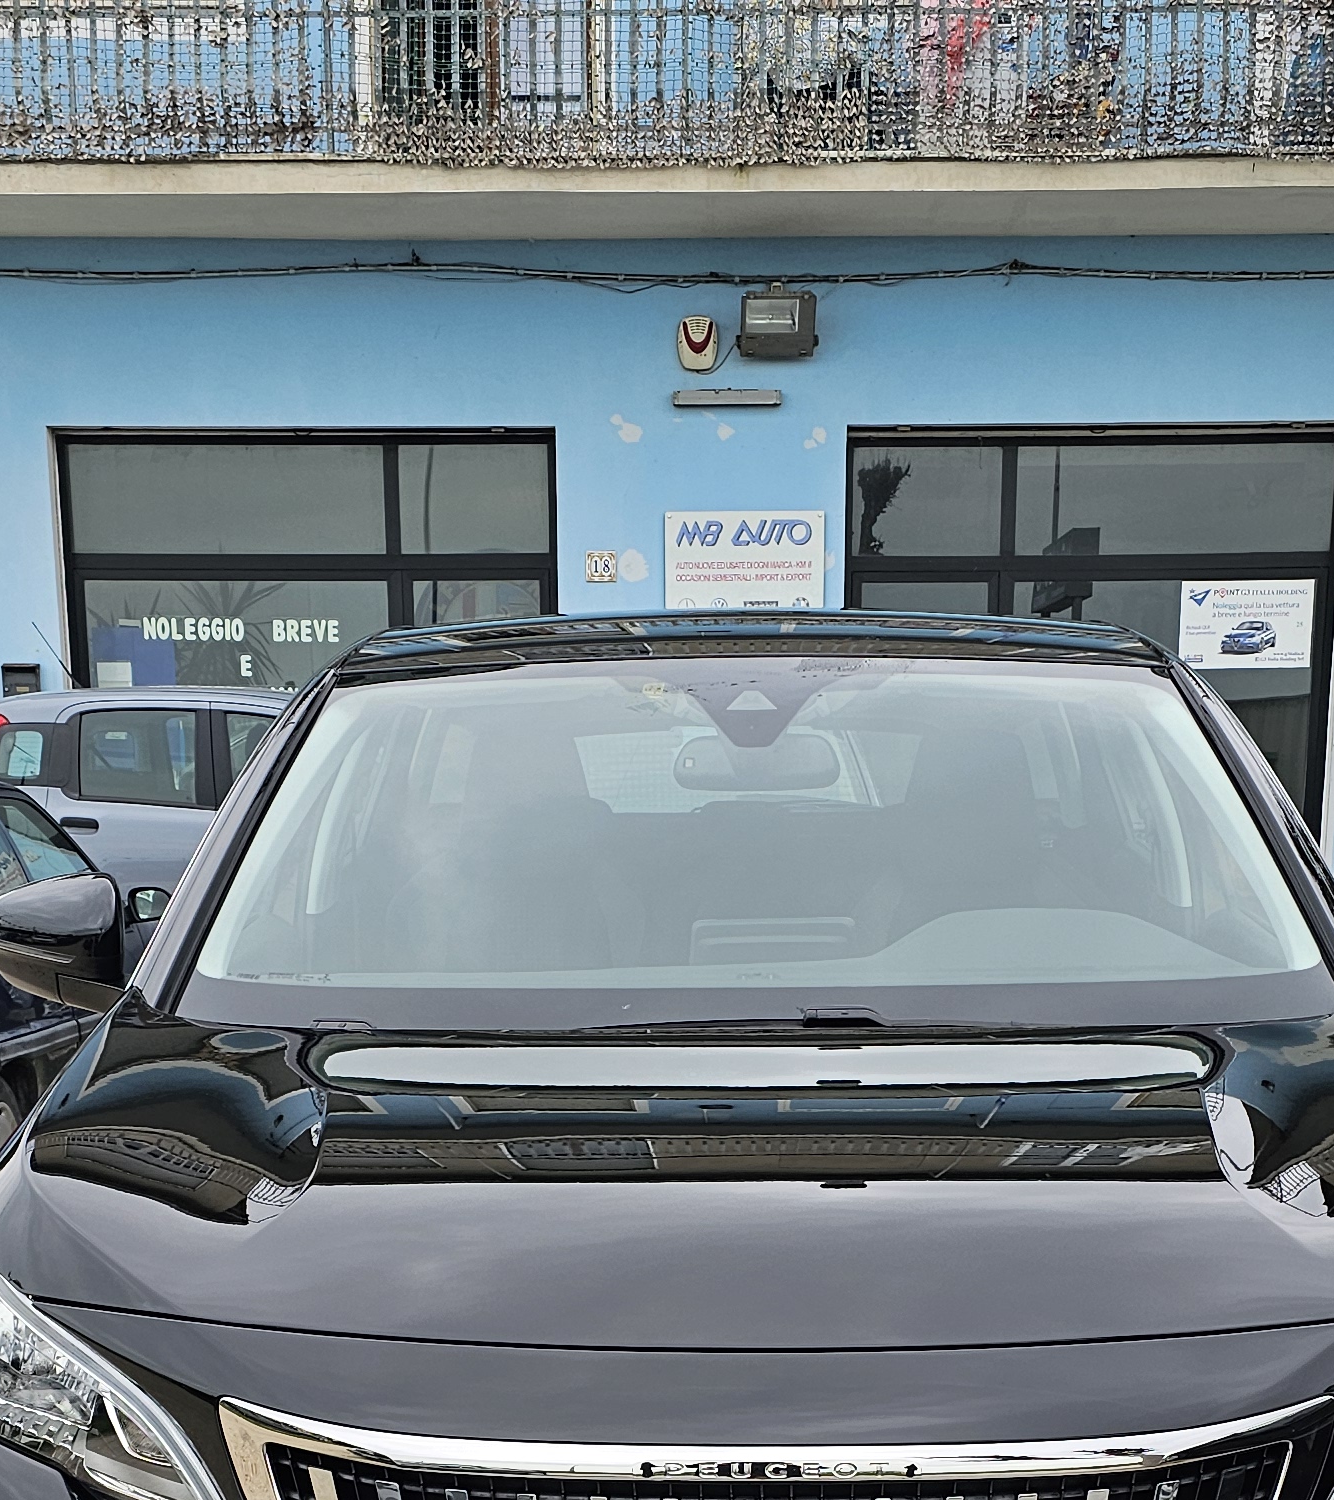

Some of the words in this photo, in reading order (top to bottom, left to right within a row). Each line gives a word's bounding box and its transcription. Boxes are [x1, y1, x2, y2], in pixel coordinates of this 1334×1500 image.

[676, 520, 723, 547] MB
[731, 519, 812, 547] AUTO
[593, 559, 610, 574] 18
[676, 561, 693, 570] AUTO
[694, 561, 716, 570] NUOVE
[716, 561, 726, 570] ED
[726, 561, 746, 570] USATE
[753, 561, 769, 569] OGNI
[769, 561, 793, 569] MARCA
[795, 560, 806, 568] KM
[711, 573, 751, 582] SEMESTRALI
[755, 573, 779, 581] IMPORT
[785, 573, 812, 581] EXPORT
[1276, 588, 1308, 596] HOLDING
[1212, 602, 1242, 611] Noleggia
[1274, 601, 1300, 609] vettura
[1217, 610, 1236, 618] breve
[1243, 610, 1262, 619] lungo
[1263, 609, 1290, 618] termine
[142, 616, 245, 642] NOLEGGIO
[272, 619, 339, 643] BREVE
[240, 654, 253, 677] E
[664, 1461, 890, 1479] PEUGEOT
